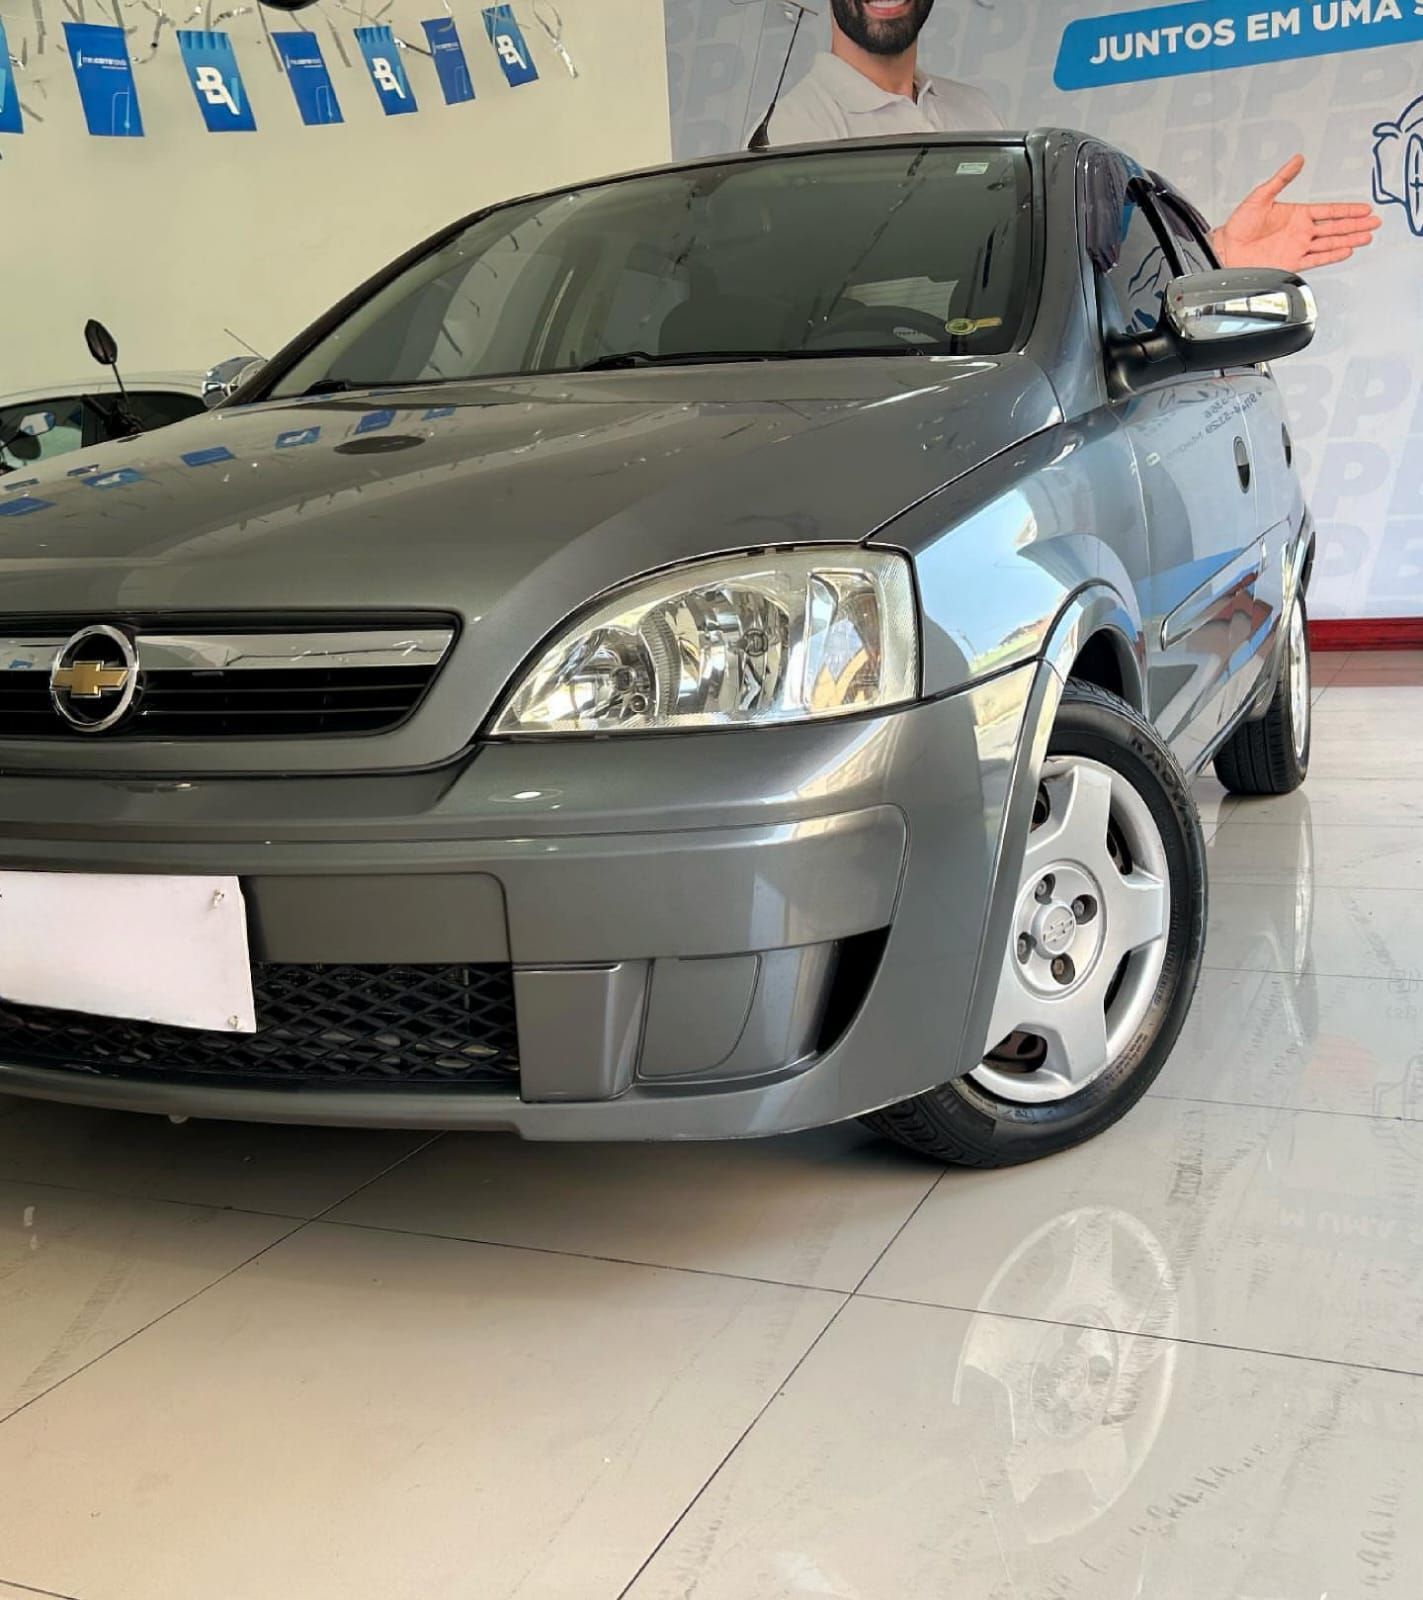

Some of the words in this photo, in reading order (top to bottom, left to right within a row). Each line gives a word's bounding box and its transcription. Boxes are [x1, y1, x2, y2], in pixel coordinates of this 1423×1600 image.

[1089, 18, 1236, 65] JUNTOS
[1246, 7, 1301, 42] EM
[1312, 0, 1402, 31] UMA
